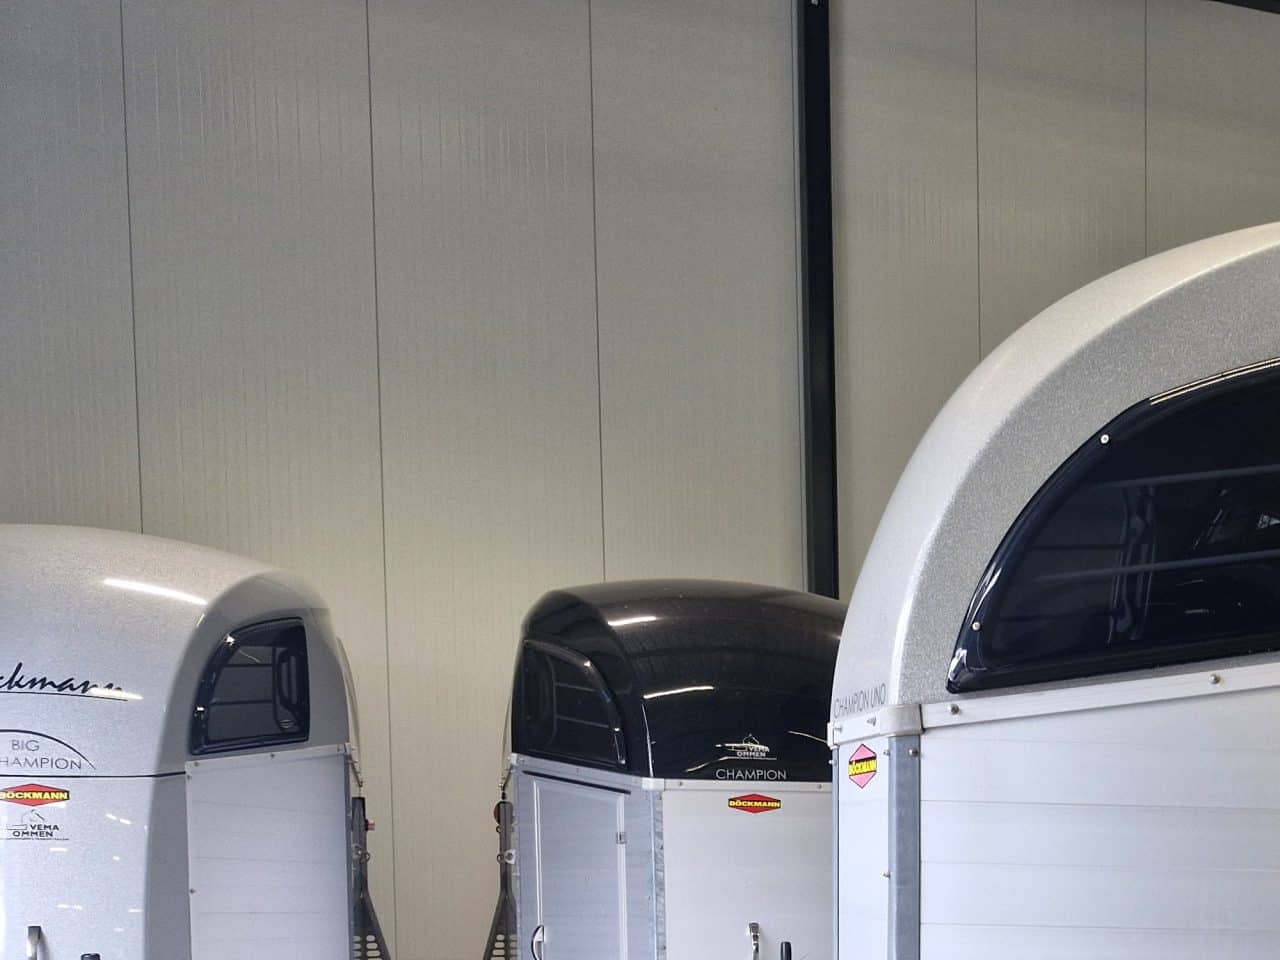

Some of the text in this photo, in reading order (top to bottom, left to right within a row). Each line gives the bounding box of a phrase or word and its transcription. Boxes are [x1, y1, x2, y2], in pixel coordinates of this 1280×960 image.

[11, 739, 40, 752] BIG
[715, 768, 787, 781] CHAMPION
[729, 799, 780, 809] BÖCKMANN
[12, 830, 54, 838] OMMEN
